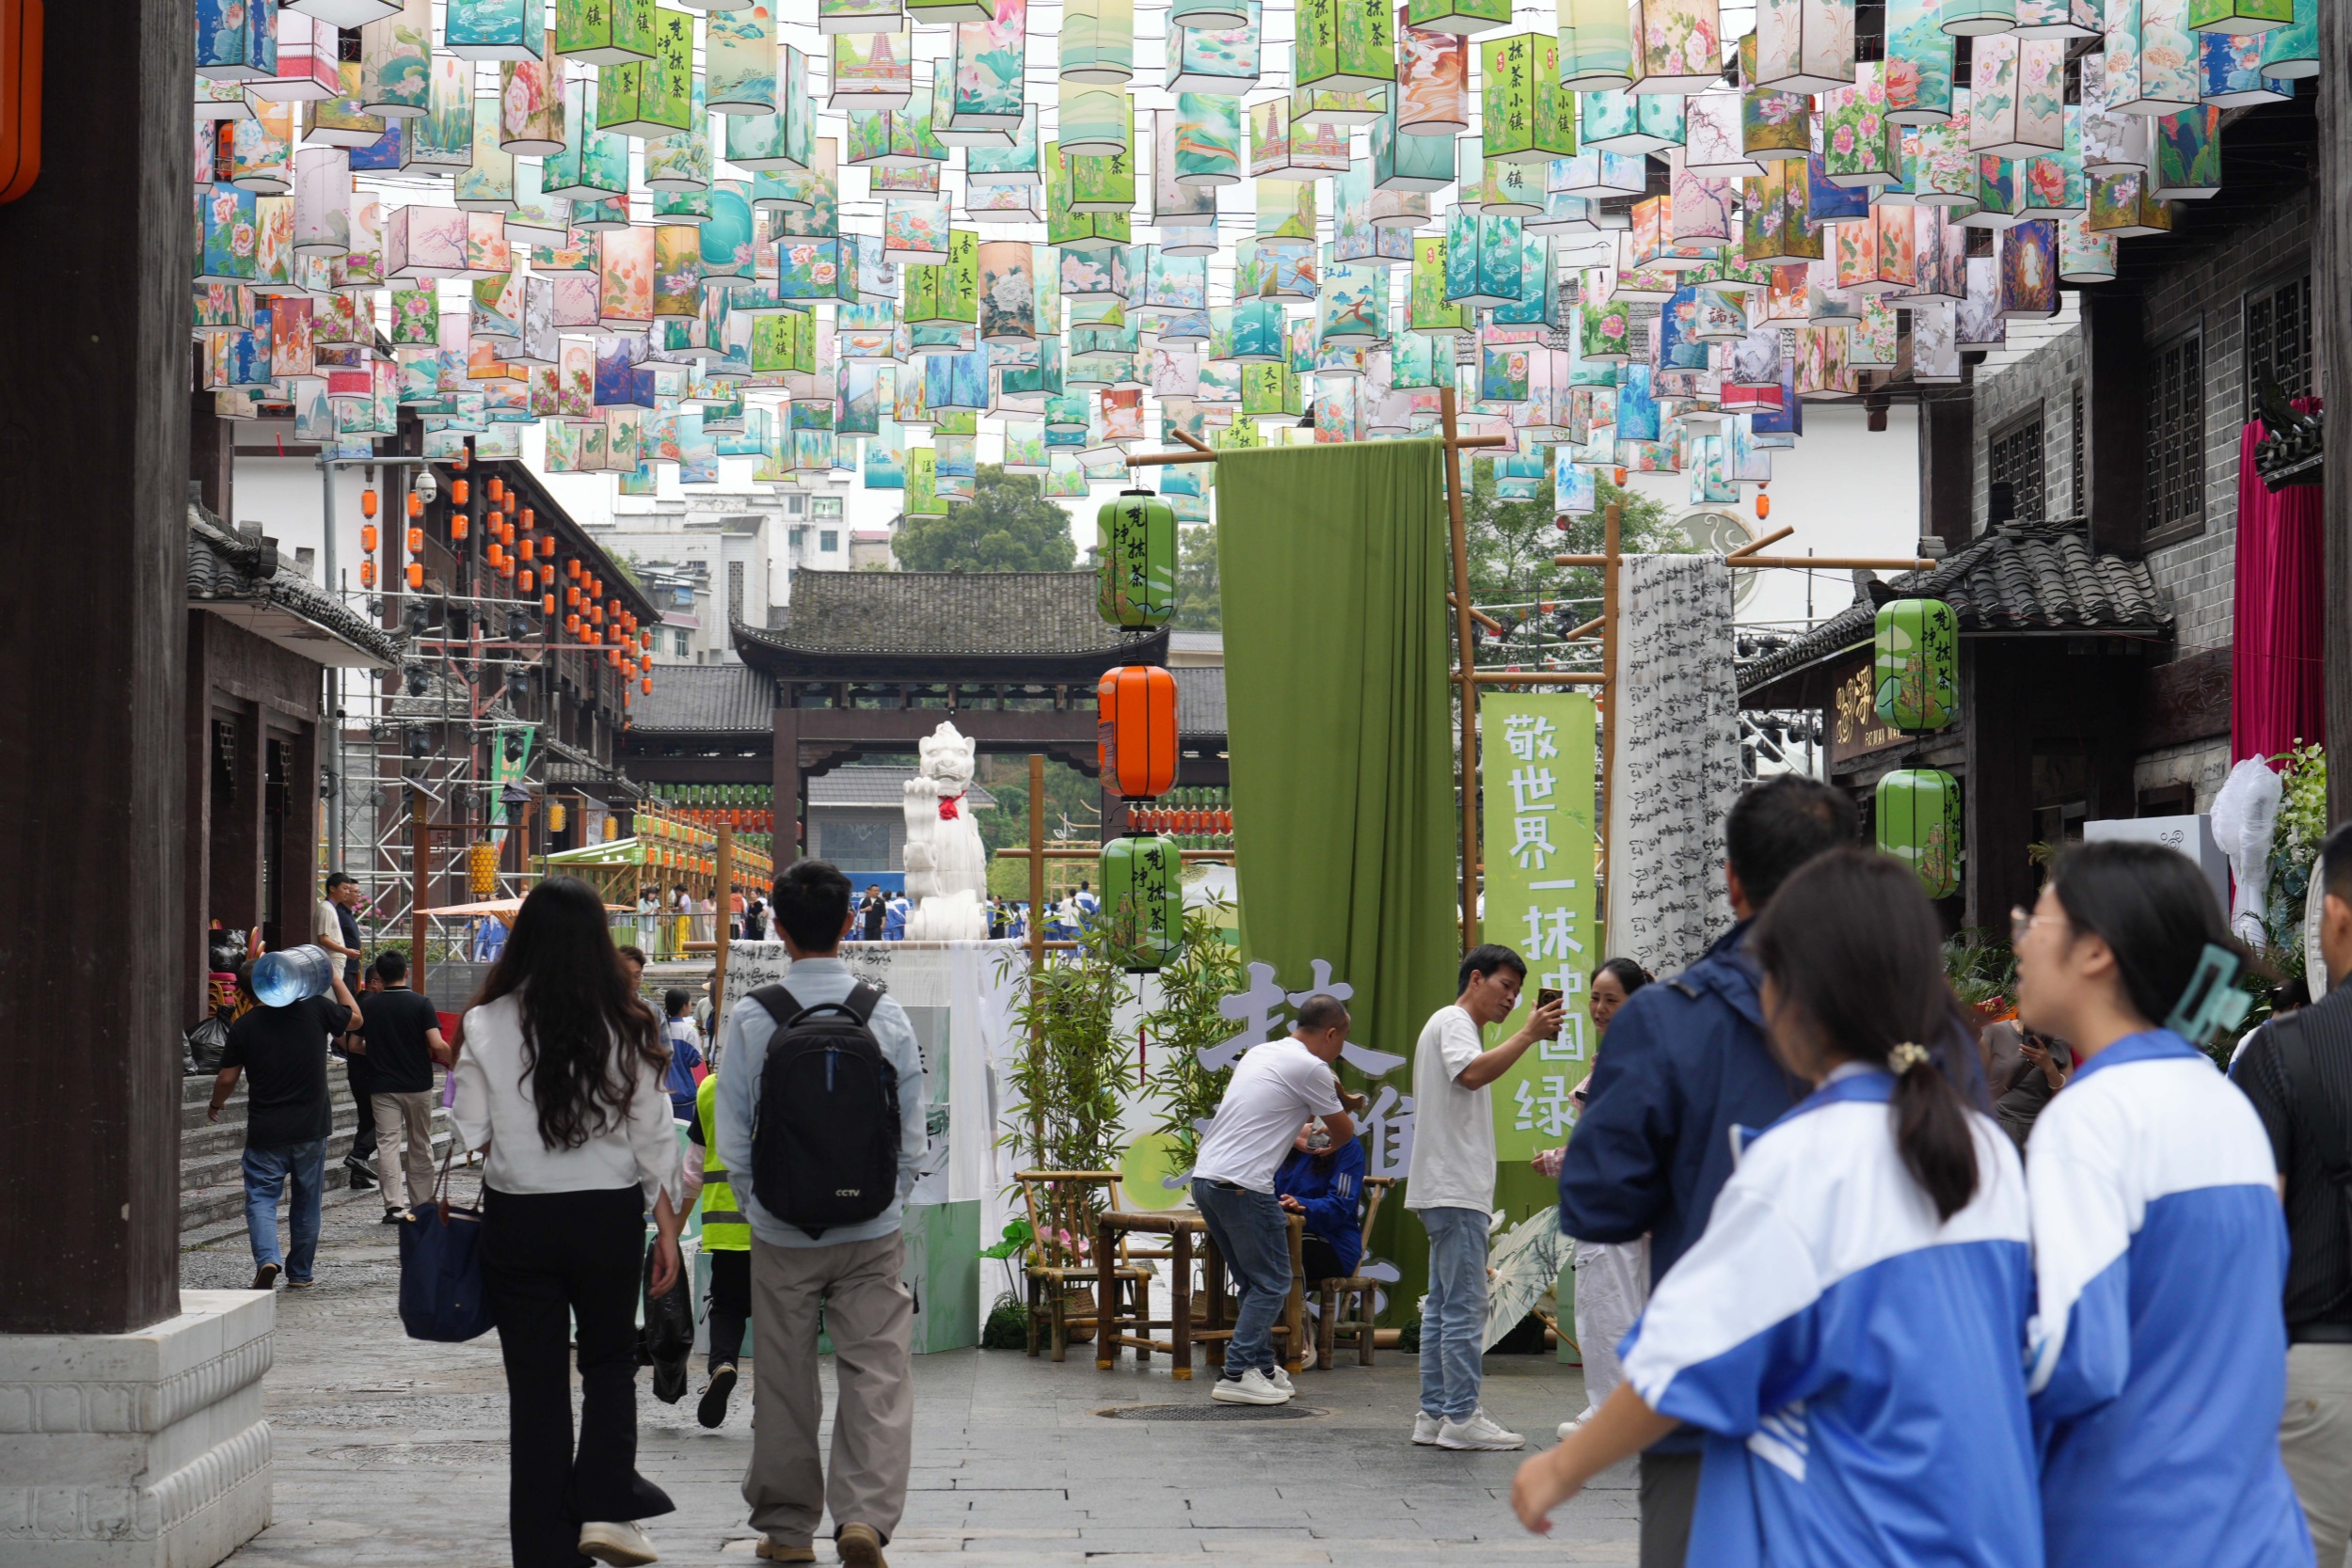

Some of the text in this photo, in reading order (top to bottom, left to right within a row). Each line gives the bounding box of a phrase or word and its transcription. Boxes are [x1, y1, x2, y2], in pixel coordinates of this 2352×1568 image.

[1508, 40, 1524, 131] 抹茶小镇
[949, 234, 973, 299] 香溢天下
[1323, 264, 1352, 279] 江山
[1708, 307, 1739, 327] 端午
[1263, 366, 1278, 394] 天下
[1113, 503, 1146, 588] 梵净抹茶
[1921, 607, 1952, 691] 梵净抹茶
[1131, 847, 1166, 931] 梵净抹茶
[835, 1188, 861, 1197] CCTV
